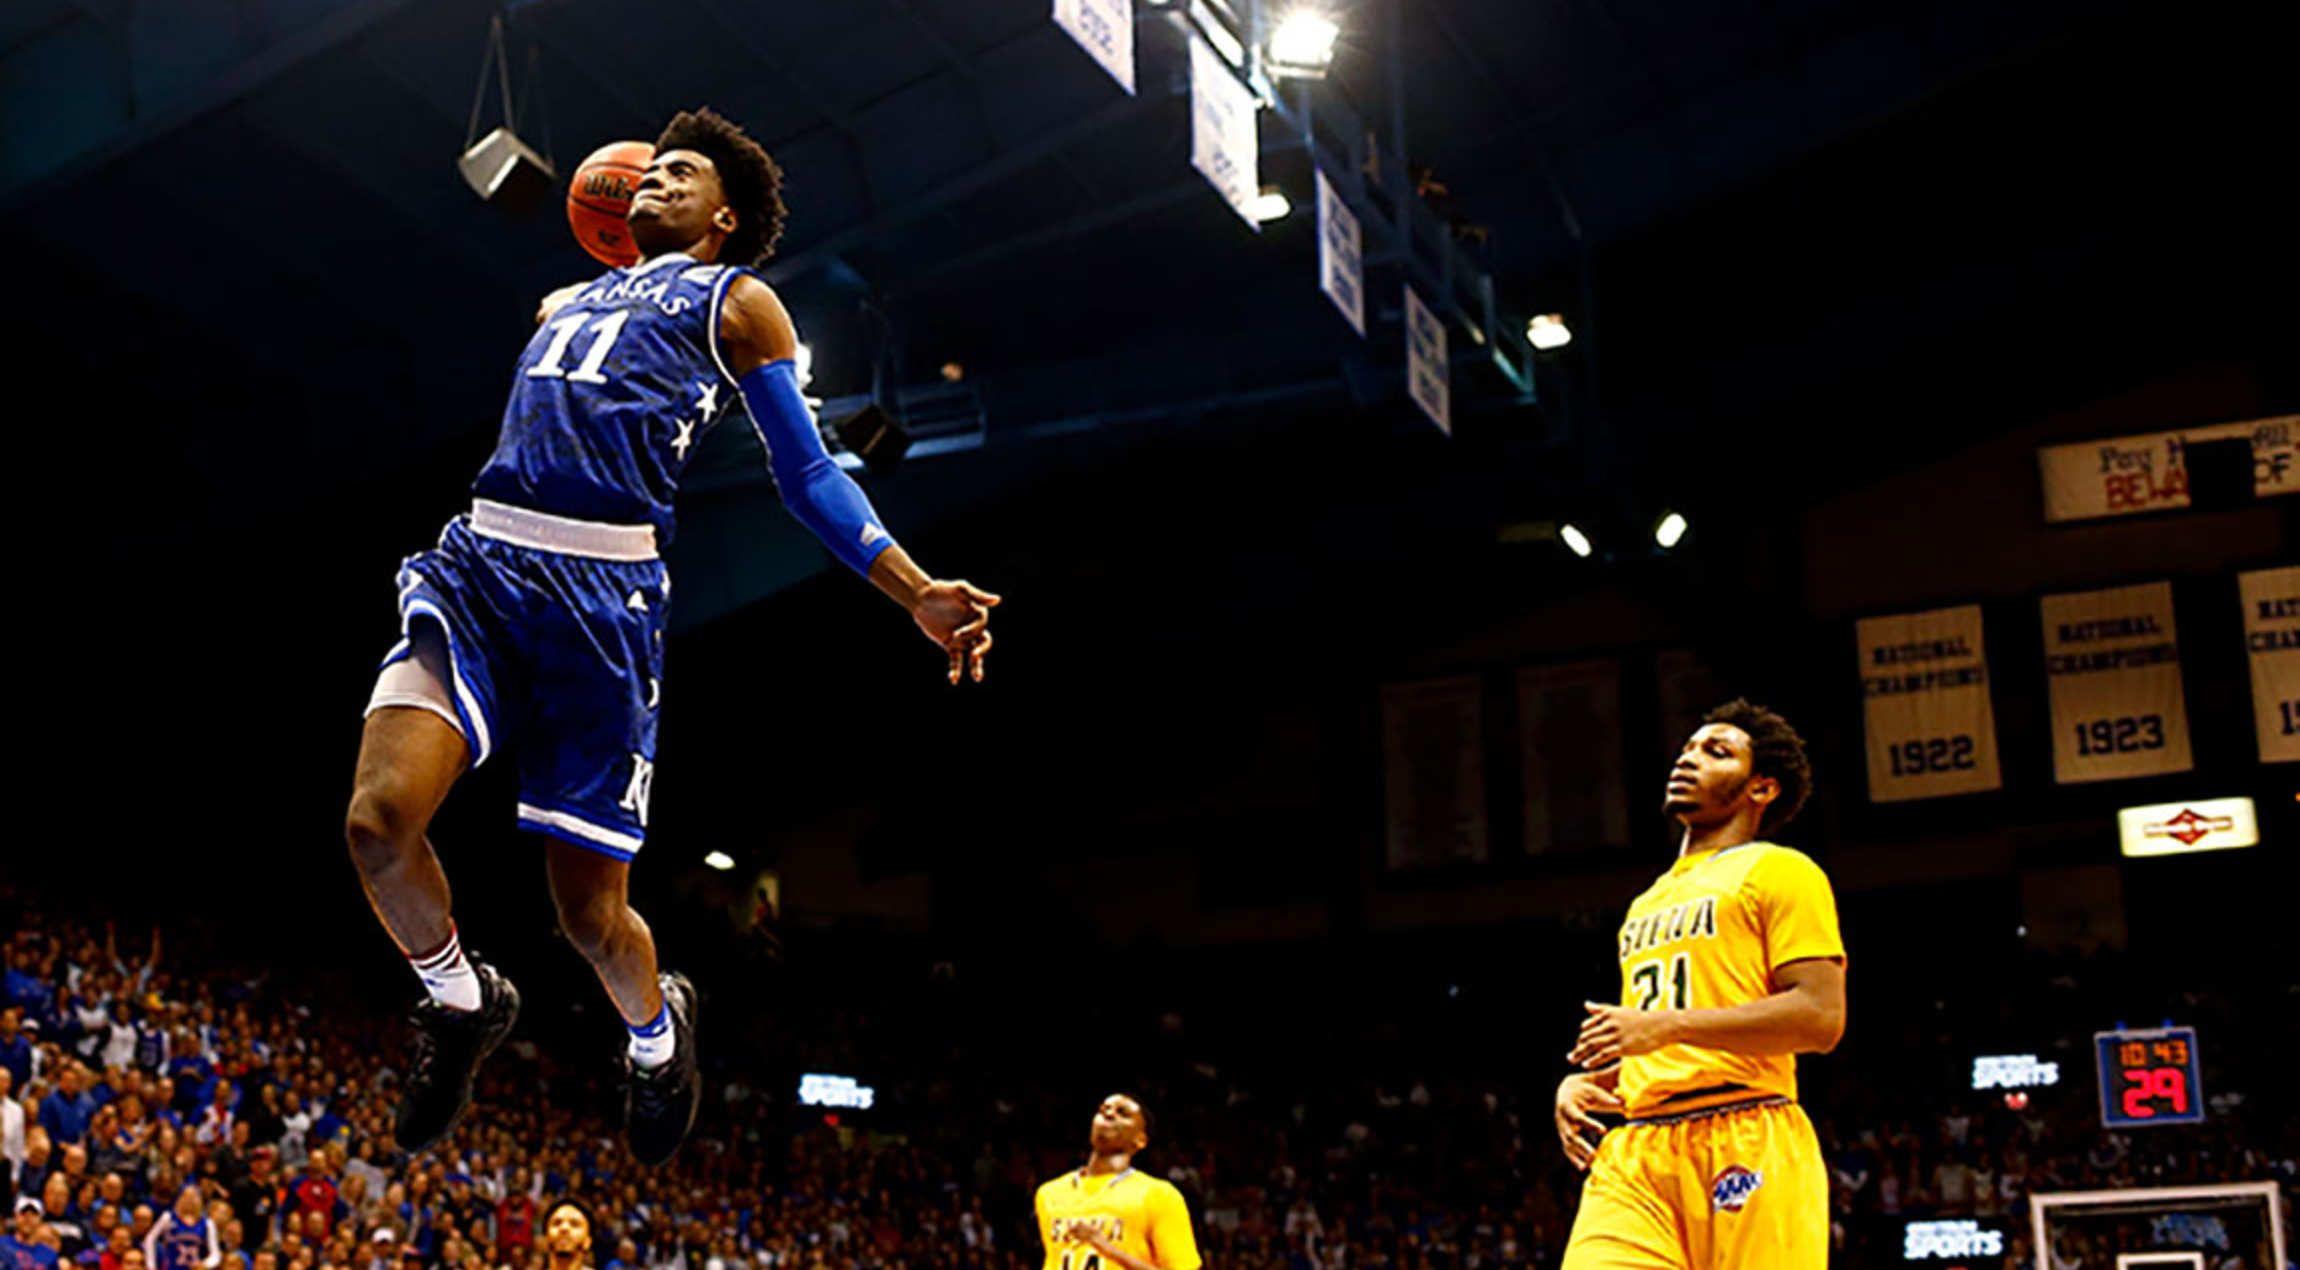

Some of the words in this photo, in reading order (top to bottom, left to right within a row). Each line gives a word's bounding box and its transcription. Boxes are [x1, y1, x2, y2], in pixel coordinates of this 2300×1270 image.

[578, 276, 692, 316] ANSAS
[525, 309, 630, 385] 11
[2105, 468, 2189, 509] BEWA
[2252, 453, 2292, 485] OF
[2057, 613, 2164, 643] NATIONAL
[1874, 636, 1972, 665] NATIONAL
[1889, 734, 1976, 777] 1922
[2076, 714, 2165, 756] 1923
[2122, 1067, 2187, 1118] 29
[1904, 1230, 2002, 1259] SPORTS
